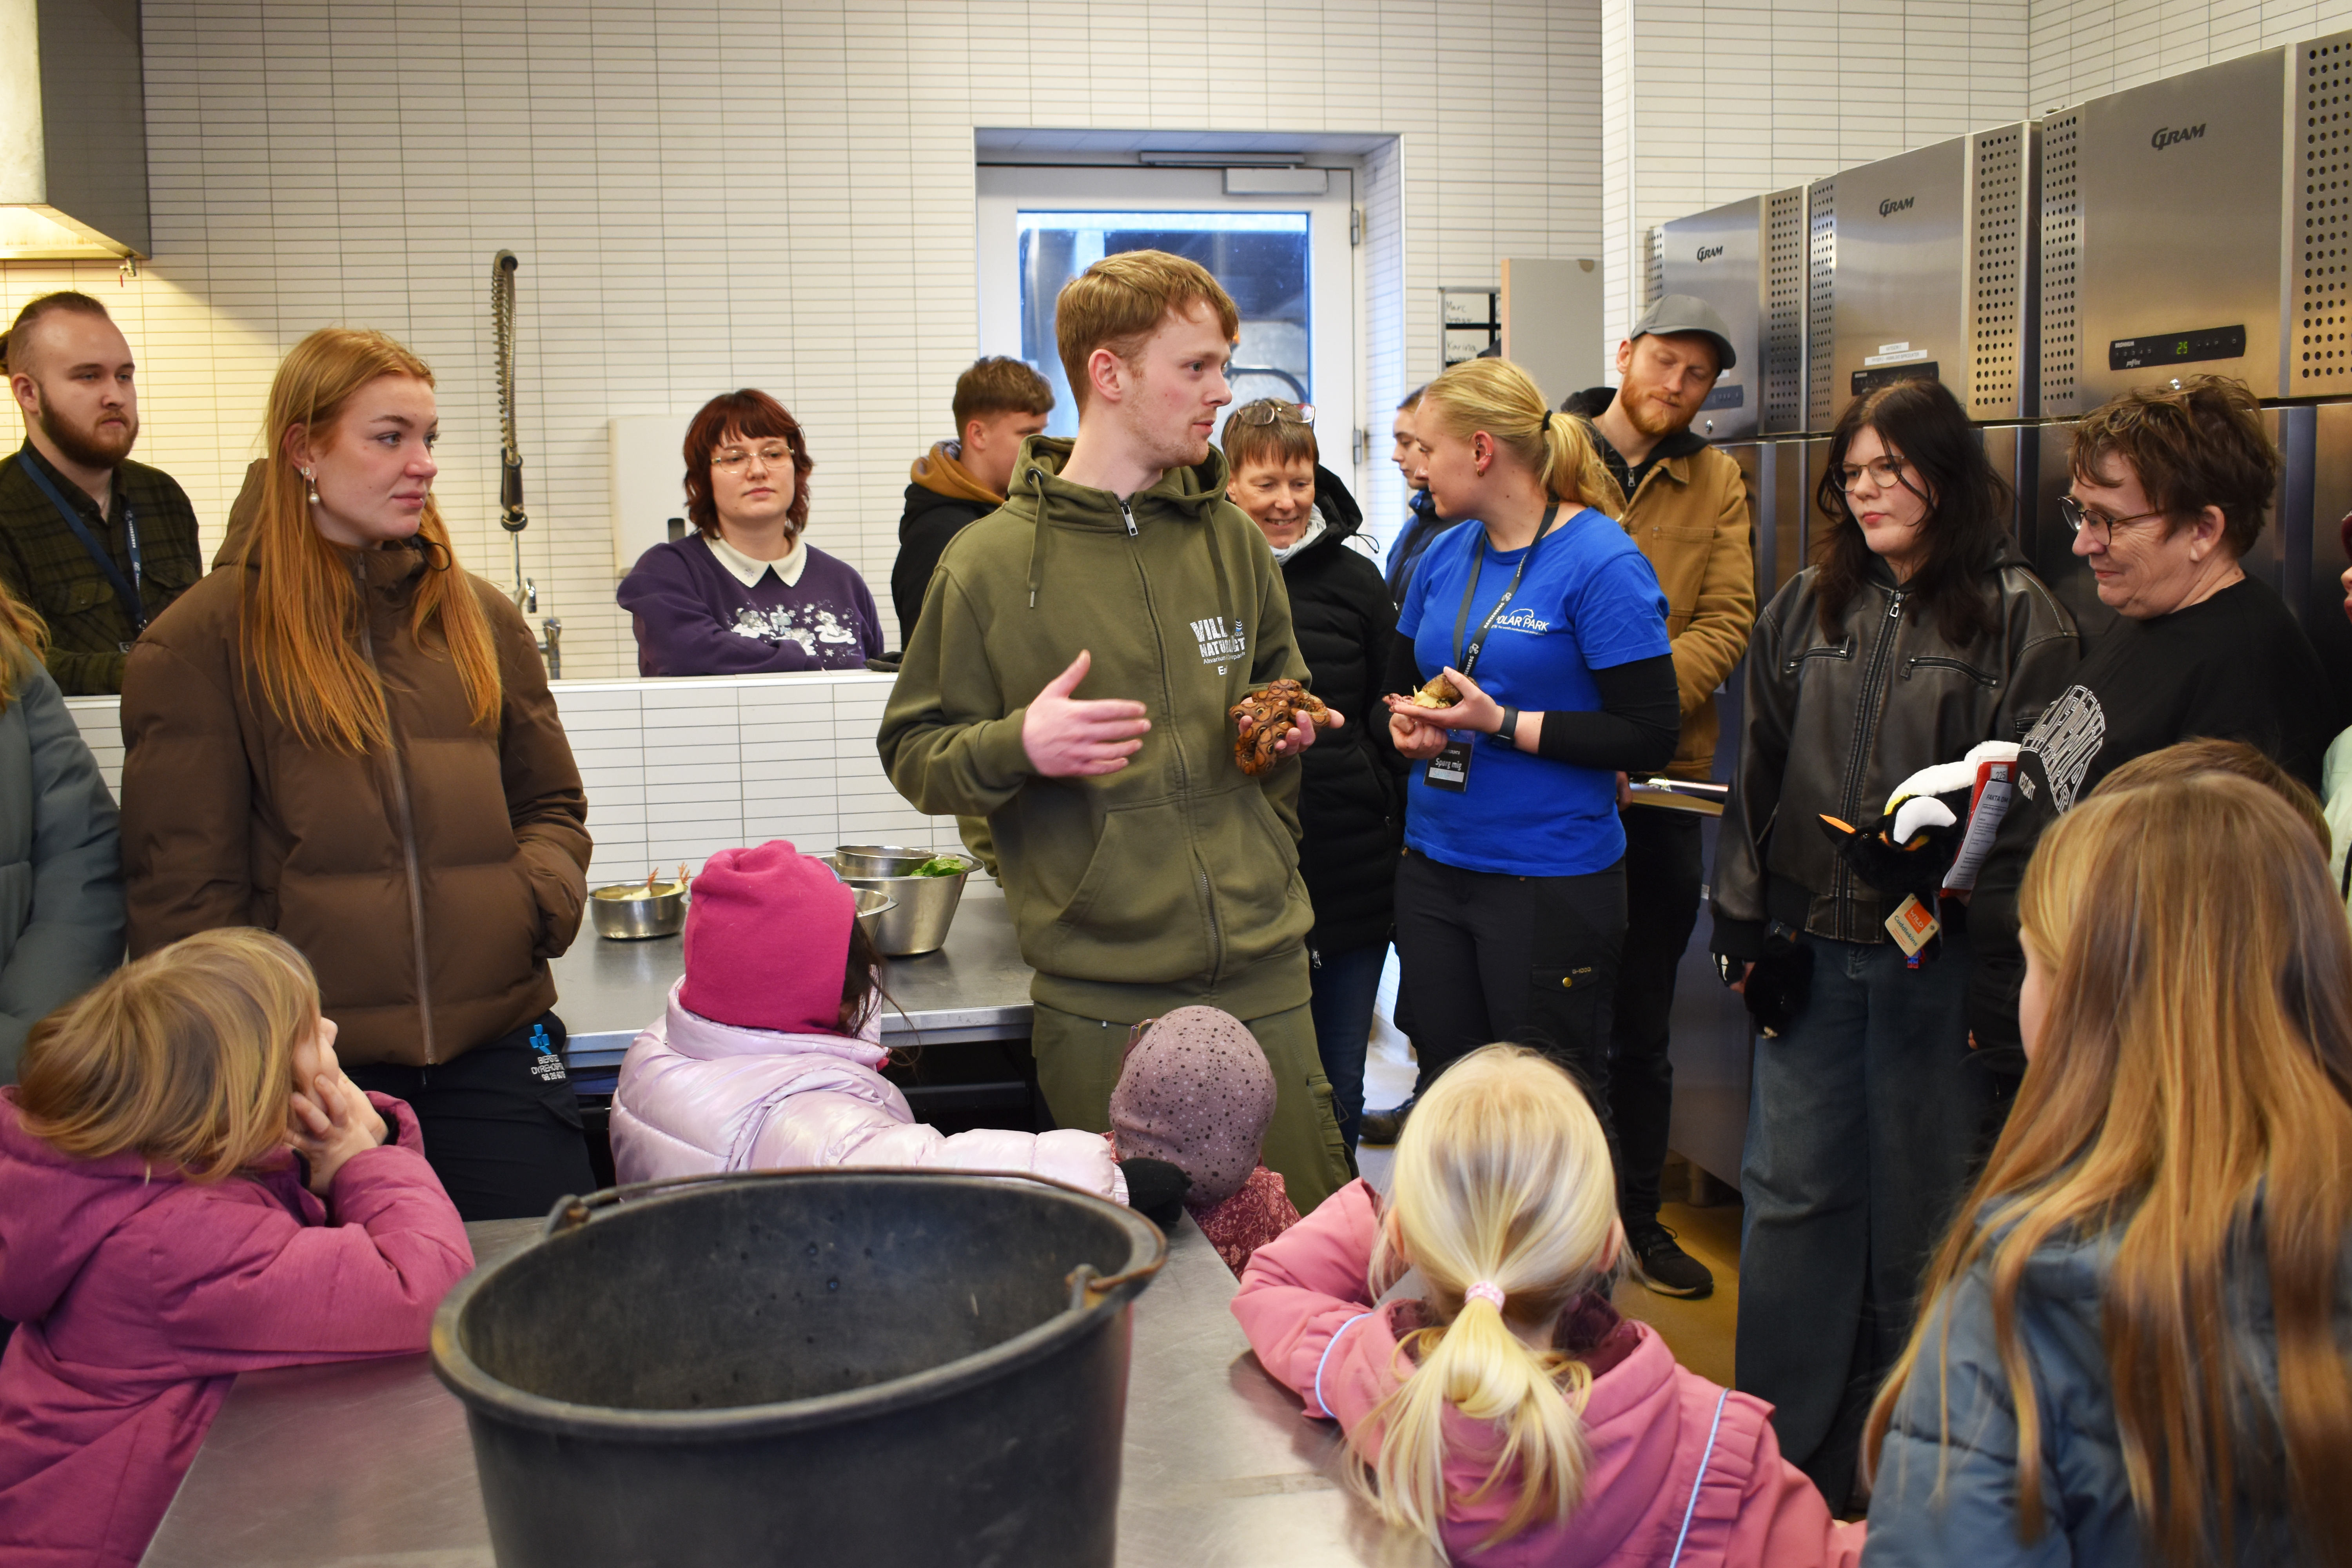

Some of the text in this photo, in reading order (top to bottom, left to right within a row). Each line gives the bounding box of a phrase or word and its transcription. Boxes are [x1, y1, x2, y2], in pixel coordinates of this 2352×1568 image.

[2151, 123, 2206, 151] GRAM
[1879, 196, 1915, 218] GRAM
[1697, 245, 1723, 263] GRAM
[1483, 602, 1505, 628] HANSENBERG
[1523, 618, 1550, 632] PARK
[1464, 655, 1474, 676] SENBERG
[1451, 760, 1462, 771] mig
[1995, 771, 2006, 780] 225
[1910, 909, 1924, 928] WILD
[1894, 915, 1918, 946] Cuddlekins
